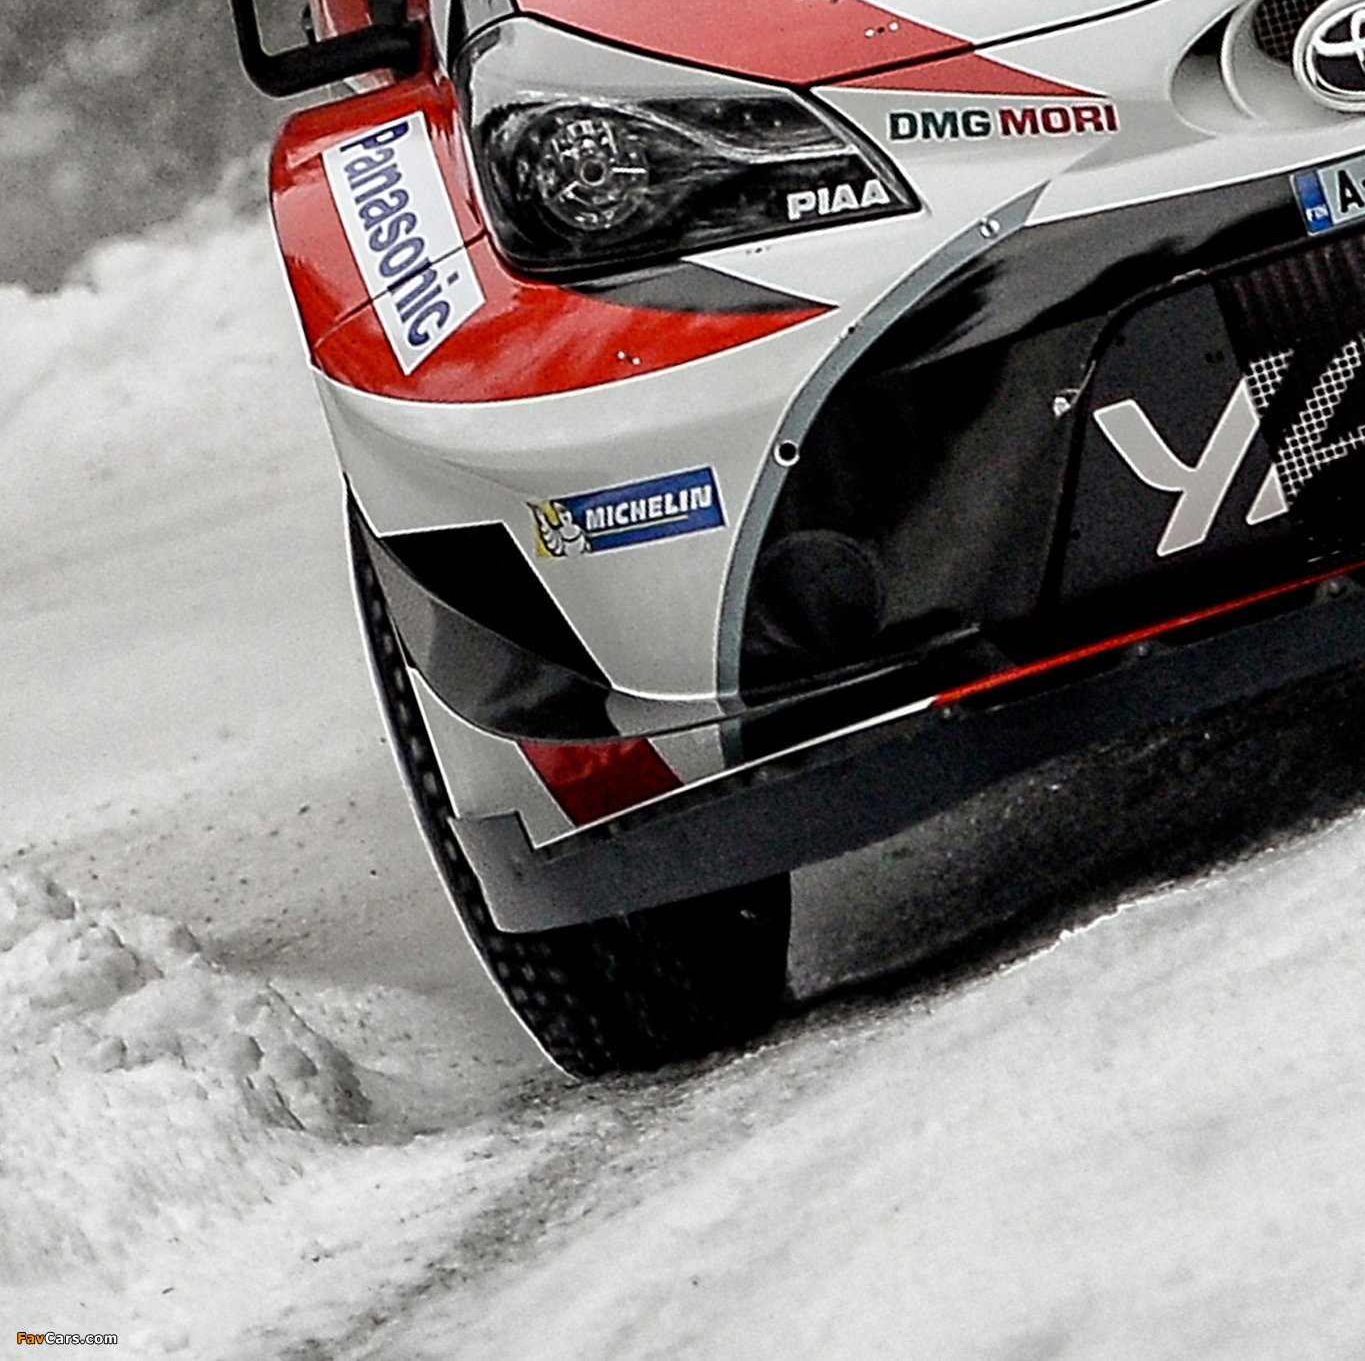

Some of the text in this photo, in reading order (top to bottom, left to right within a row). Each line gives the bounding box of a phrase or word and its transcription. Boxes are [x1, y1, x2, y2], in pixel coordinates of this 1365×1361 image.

[888, 104, 1119, 140] DMG MORI
[786, 179, 891, 221] PIAA
[339, 121, 459, 349] Panasonic
[585, 484, 713, 531] MICHELIN
